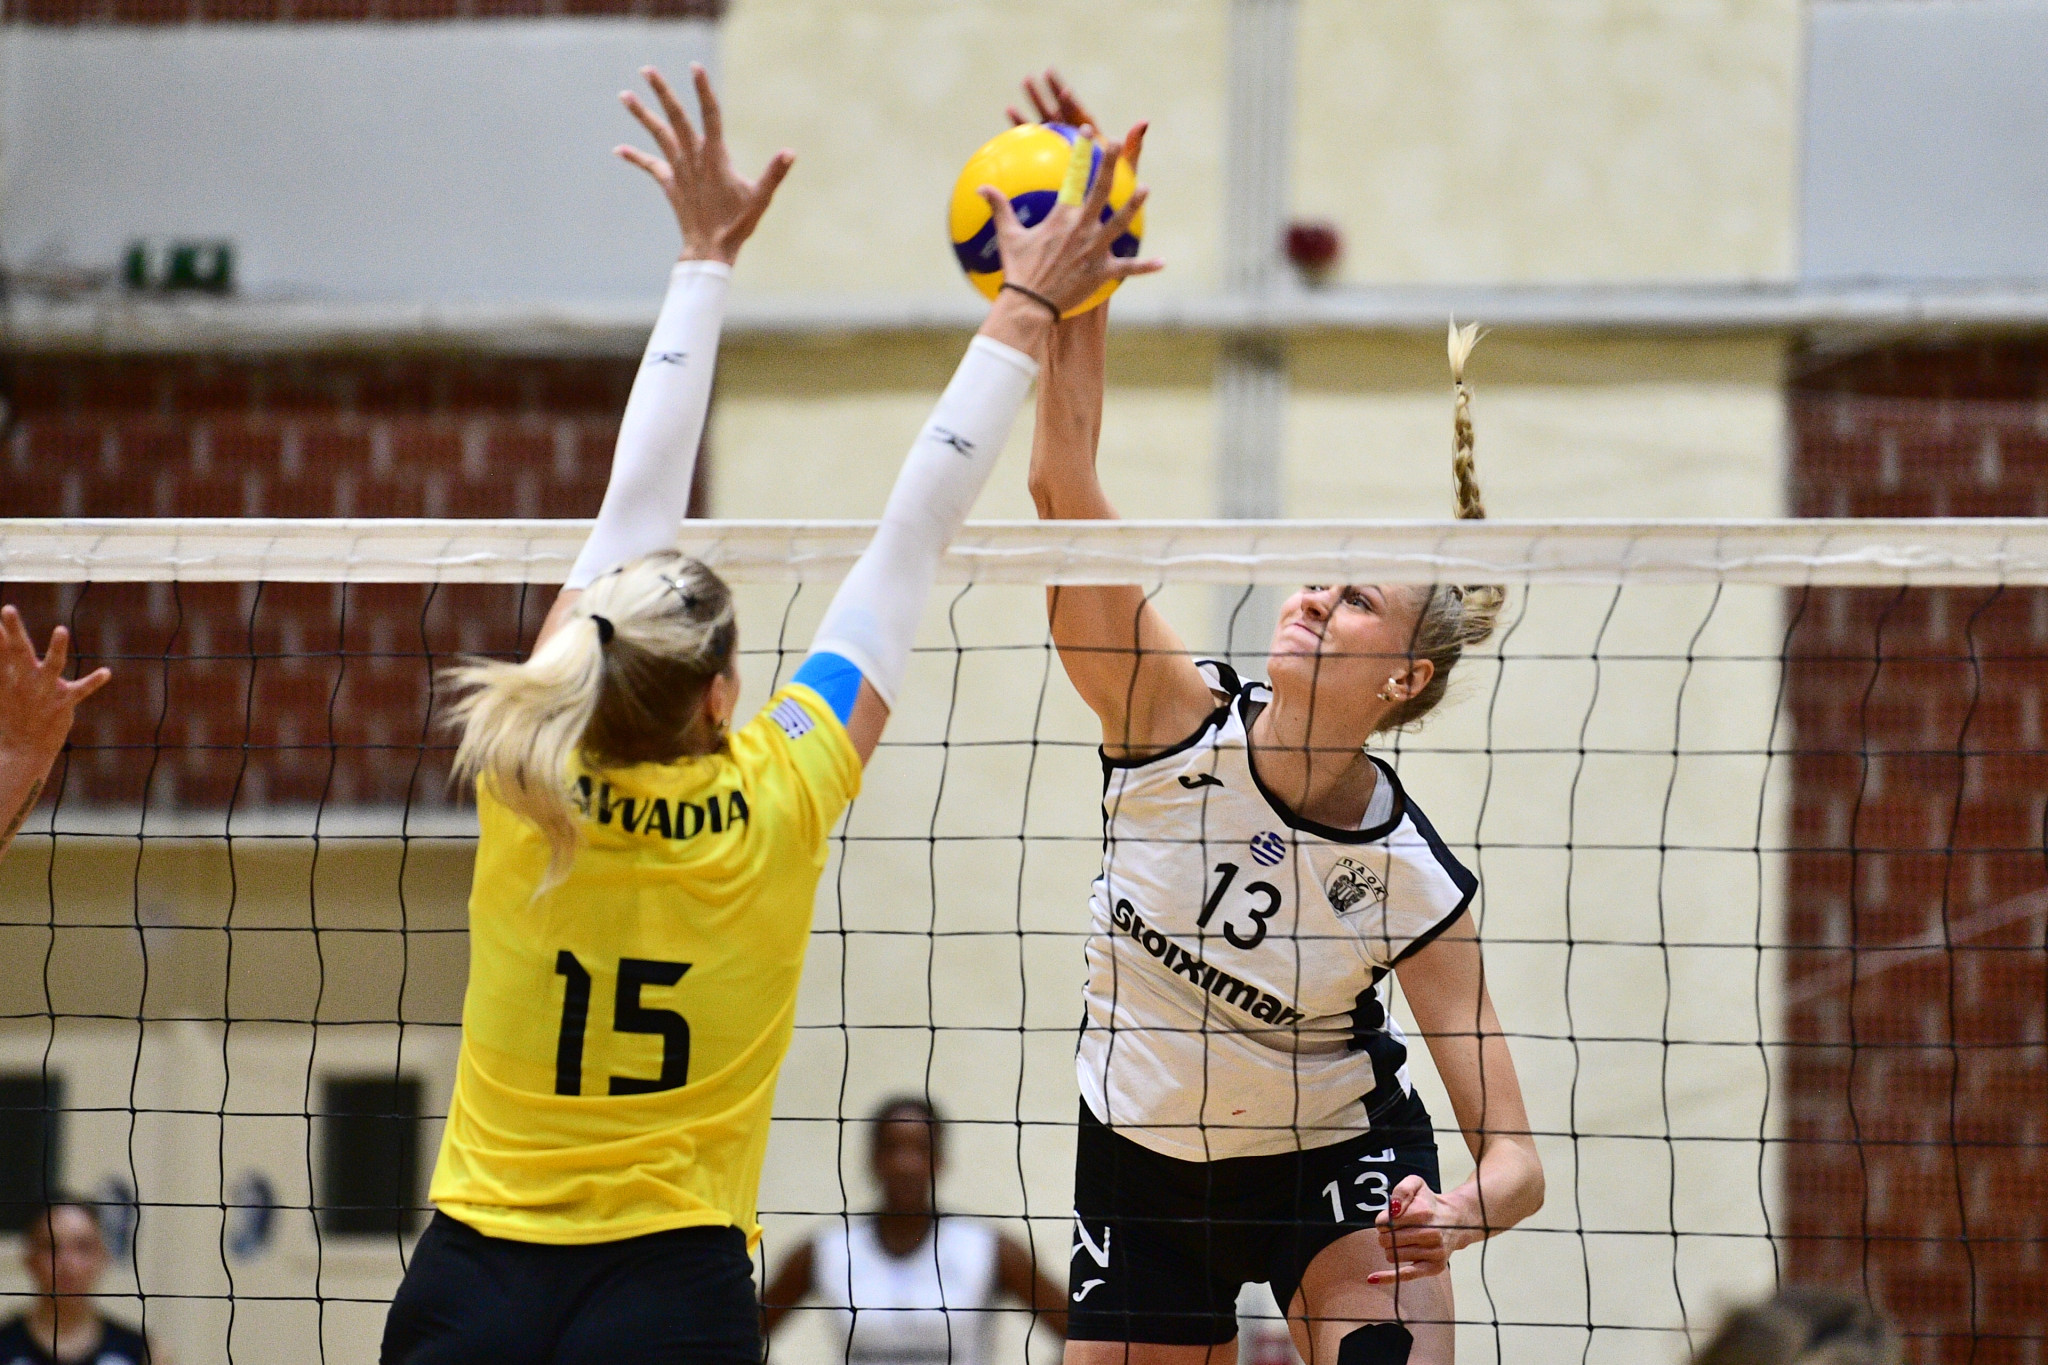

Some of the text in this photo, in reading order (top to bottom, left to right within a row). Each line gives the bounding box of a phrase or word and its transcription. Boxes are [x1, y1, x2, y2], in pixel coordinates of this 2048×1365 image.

[1196, 862, 1282, 950] 13
[555, 950, 692, 1096] 15
[1321, 1171, 1390, 1223] 13
